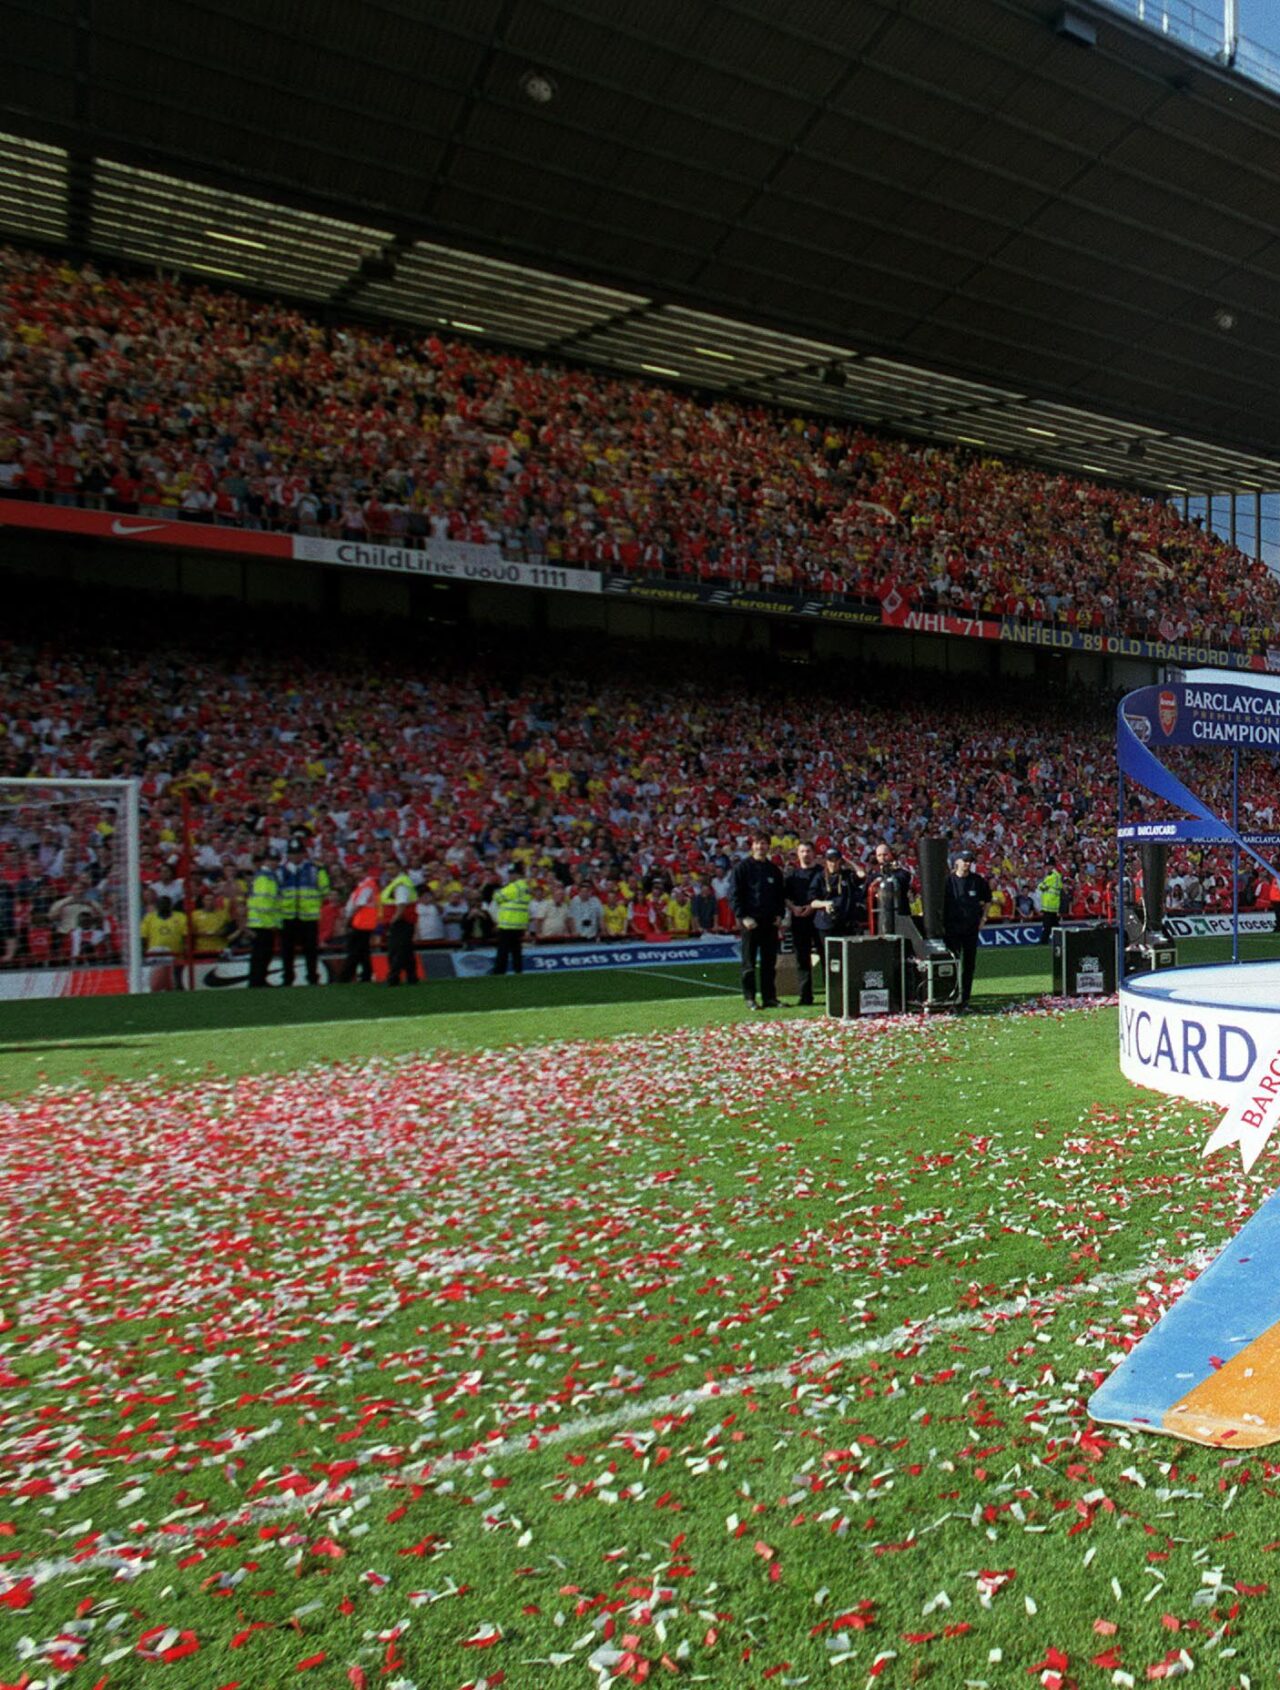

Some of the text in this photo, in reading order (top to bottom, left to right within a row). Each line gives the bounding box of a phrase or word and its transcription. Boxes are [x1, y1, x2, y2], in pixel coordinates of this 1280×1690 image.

[529, 568, 568, 587] 1111
[629, 585, 700, 601] eurostar
[731, 597, 794, 613] eurostar
[821, 608, 881, 623] eurostar
[904, 611, 951, 634] WHL
[999, 622, 1073, 648] ANFIELD
[1106, 637, 1141, 655] OLD
[1146, 640, 1229, 666] TRAFFORD
[1210, 919, 1230, 932] PC
[562, 953, 608, 967] texts
[612, 951, 632, 962] to
[637, 948, 699, 962] anyone
